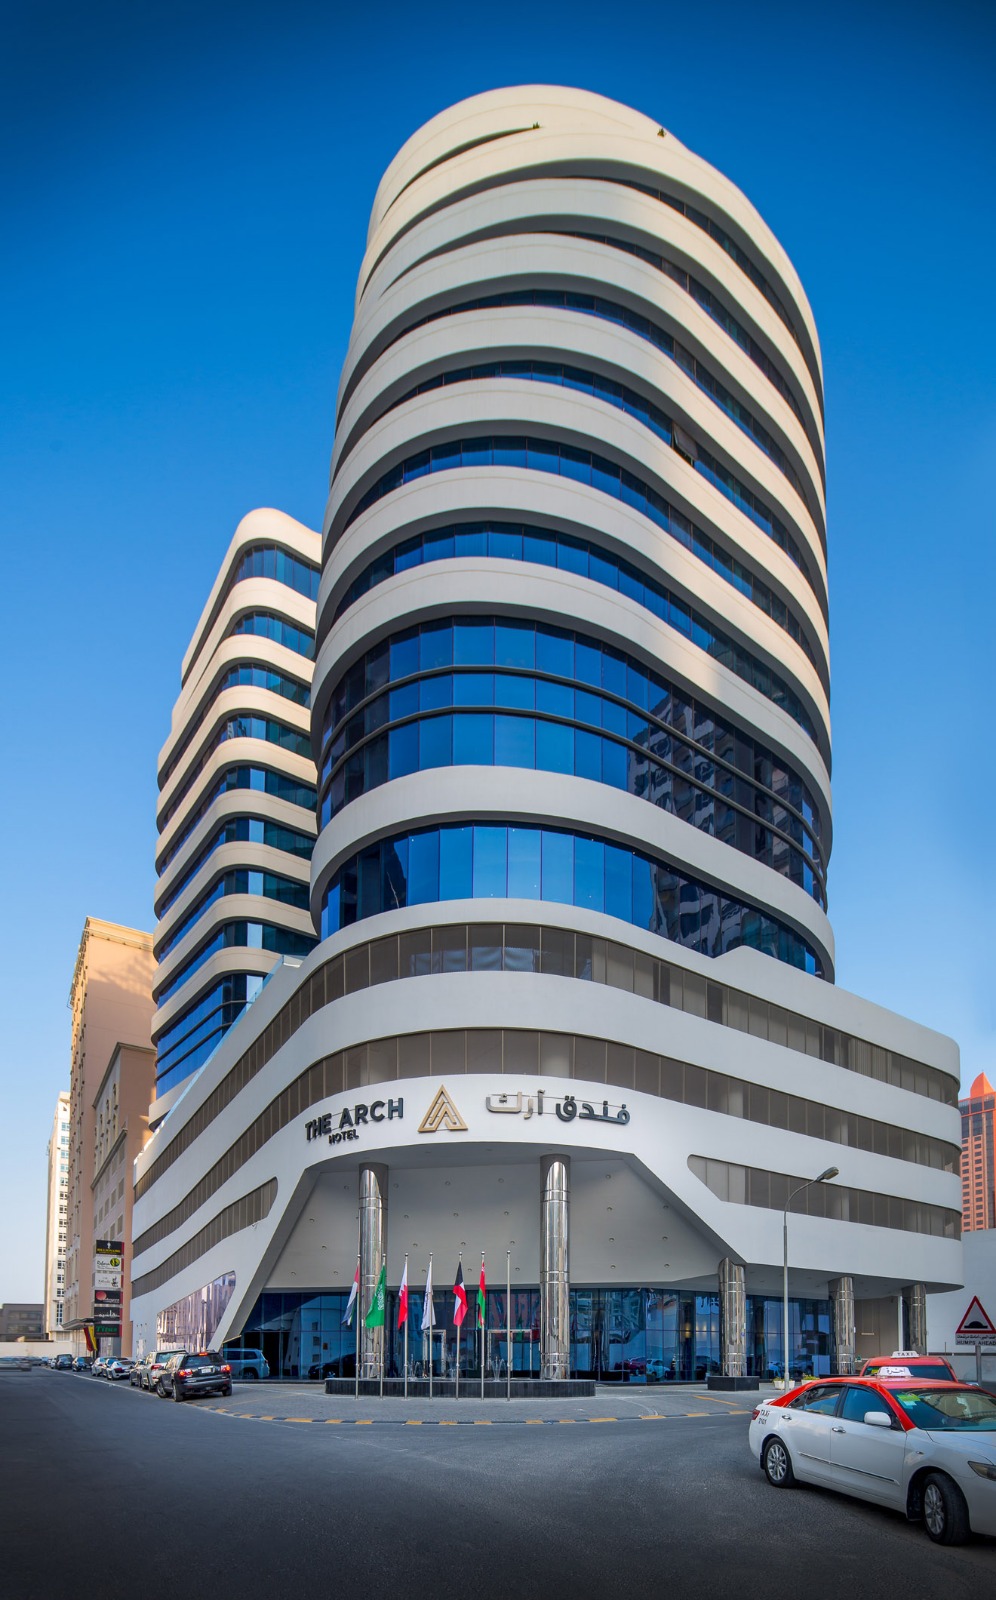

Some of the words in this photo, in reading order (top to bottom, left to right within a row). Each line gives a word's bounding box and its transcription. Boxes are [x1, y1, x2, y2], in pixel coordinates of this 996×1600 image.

[305, 1112, 332, 1141] THE
[339, 1097, 403, 1130] ARCH
[556, 1095, 630, 1125] فندق
[328, 1128, 360, 1145] HOTEL
